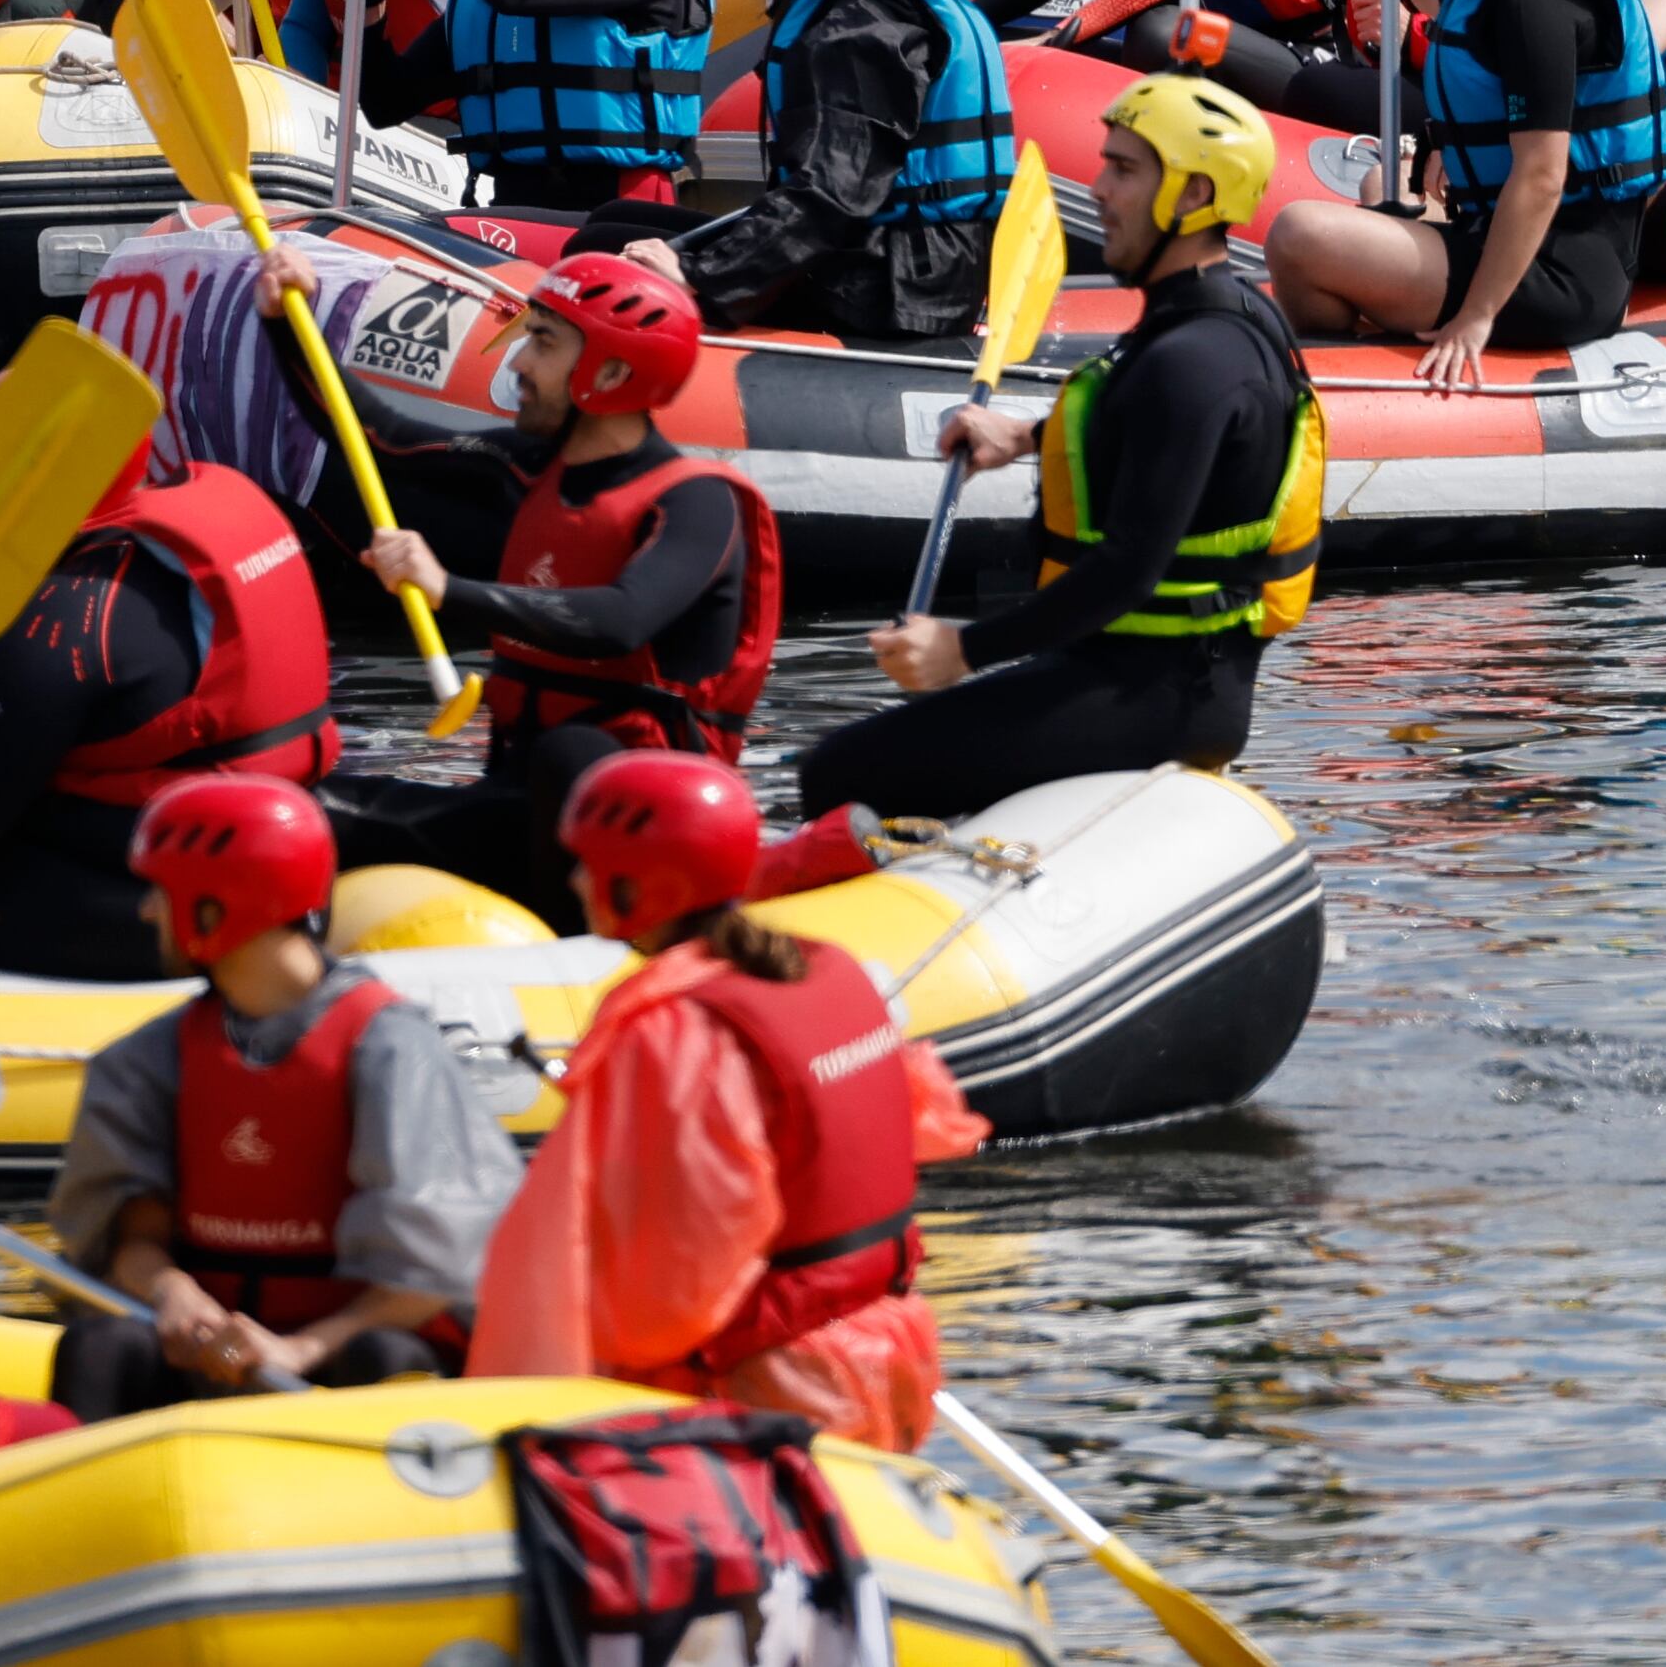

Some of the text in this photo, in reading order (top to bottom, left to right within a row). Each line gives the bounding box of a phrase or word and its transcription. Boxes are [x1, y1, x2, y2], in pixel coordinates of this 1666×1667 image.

[323, 115, 439, 185] AANTI
[353, 352, 438, 383] DESIGN
[357, 334, 442, 371] AQUA
